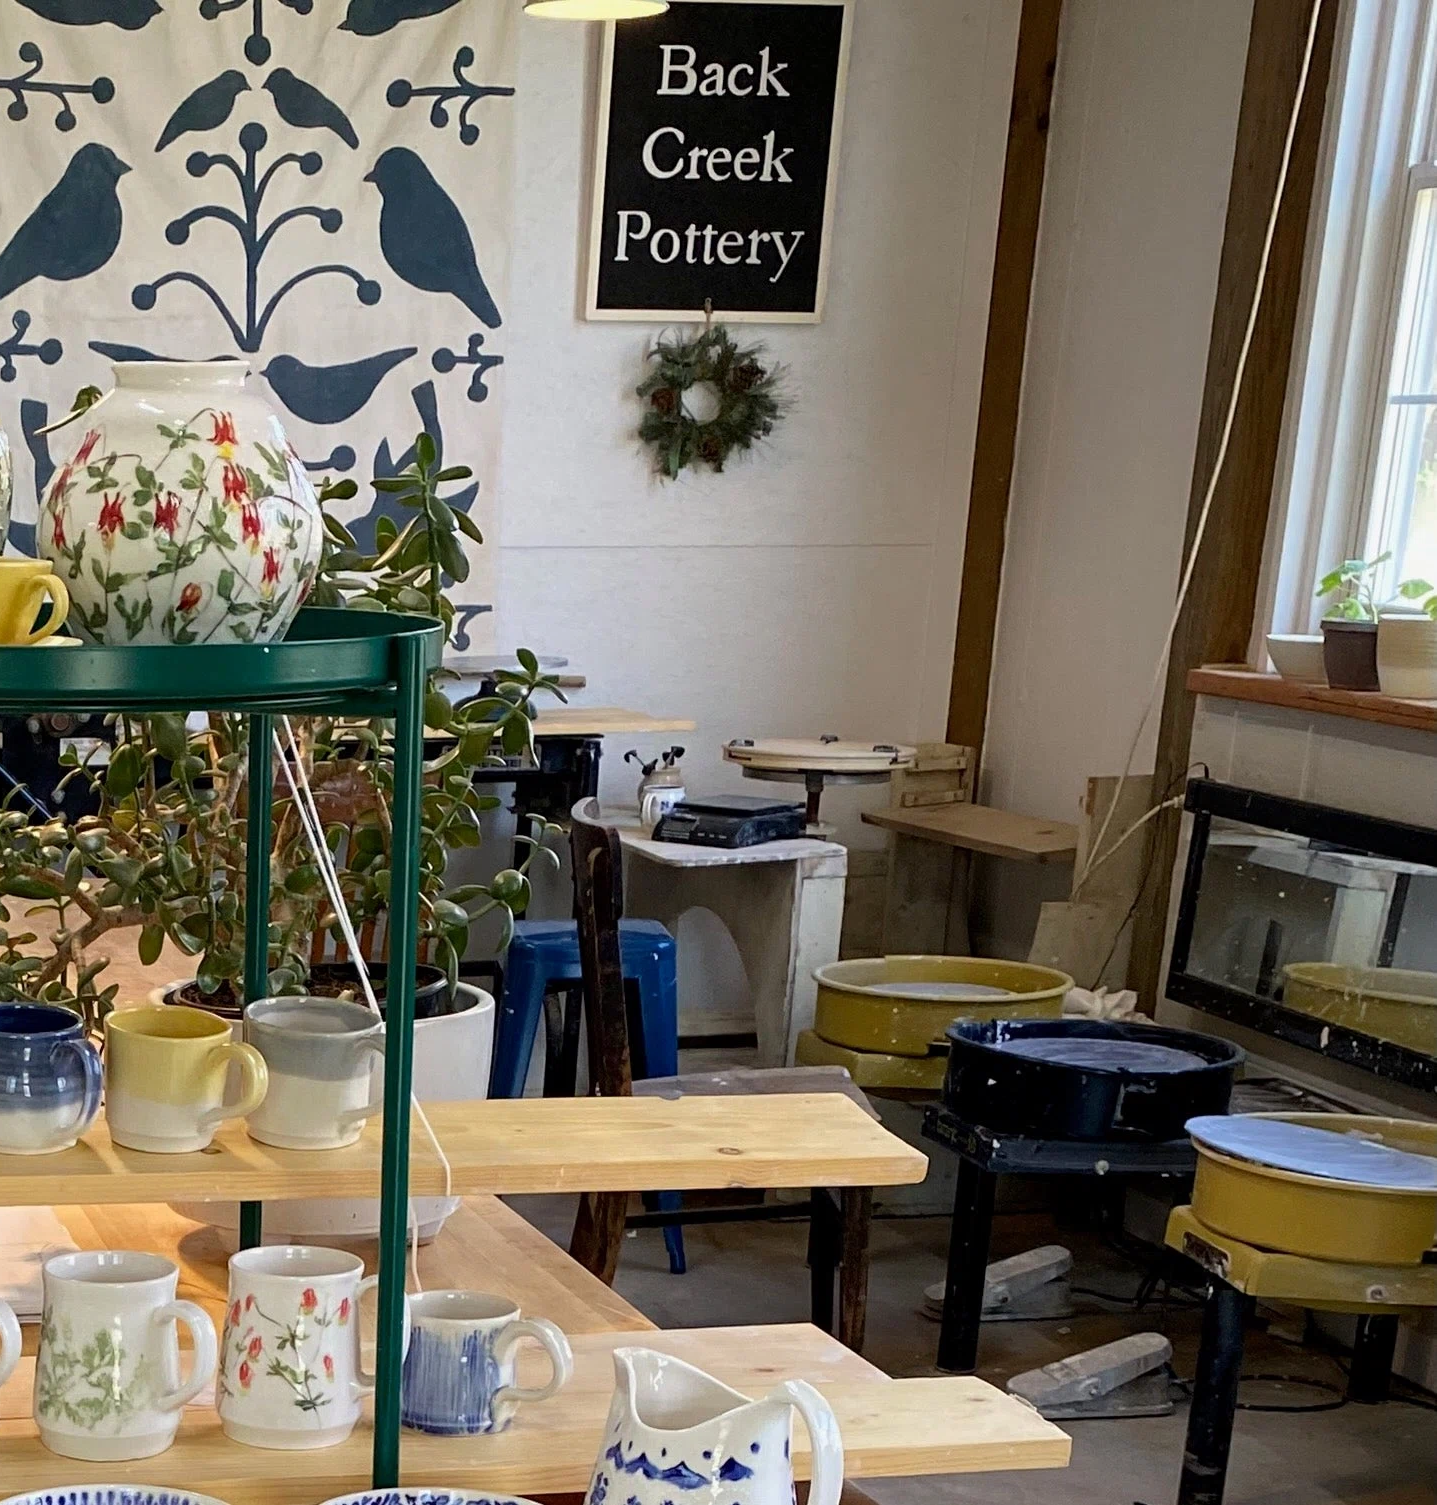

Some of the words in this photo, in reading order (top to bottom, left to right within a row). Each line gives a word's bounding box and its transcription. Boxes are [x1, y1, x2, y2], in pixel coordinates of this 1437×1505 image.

[656, 44, 791, 97] Back
[642, 126, 794, 183] Creek
[614, 210, 805, 283] Pottery
